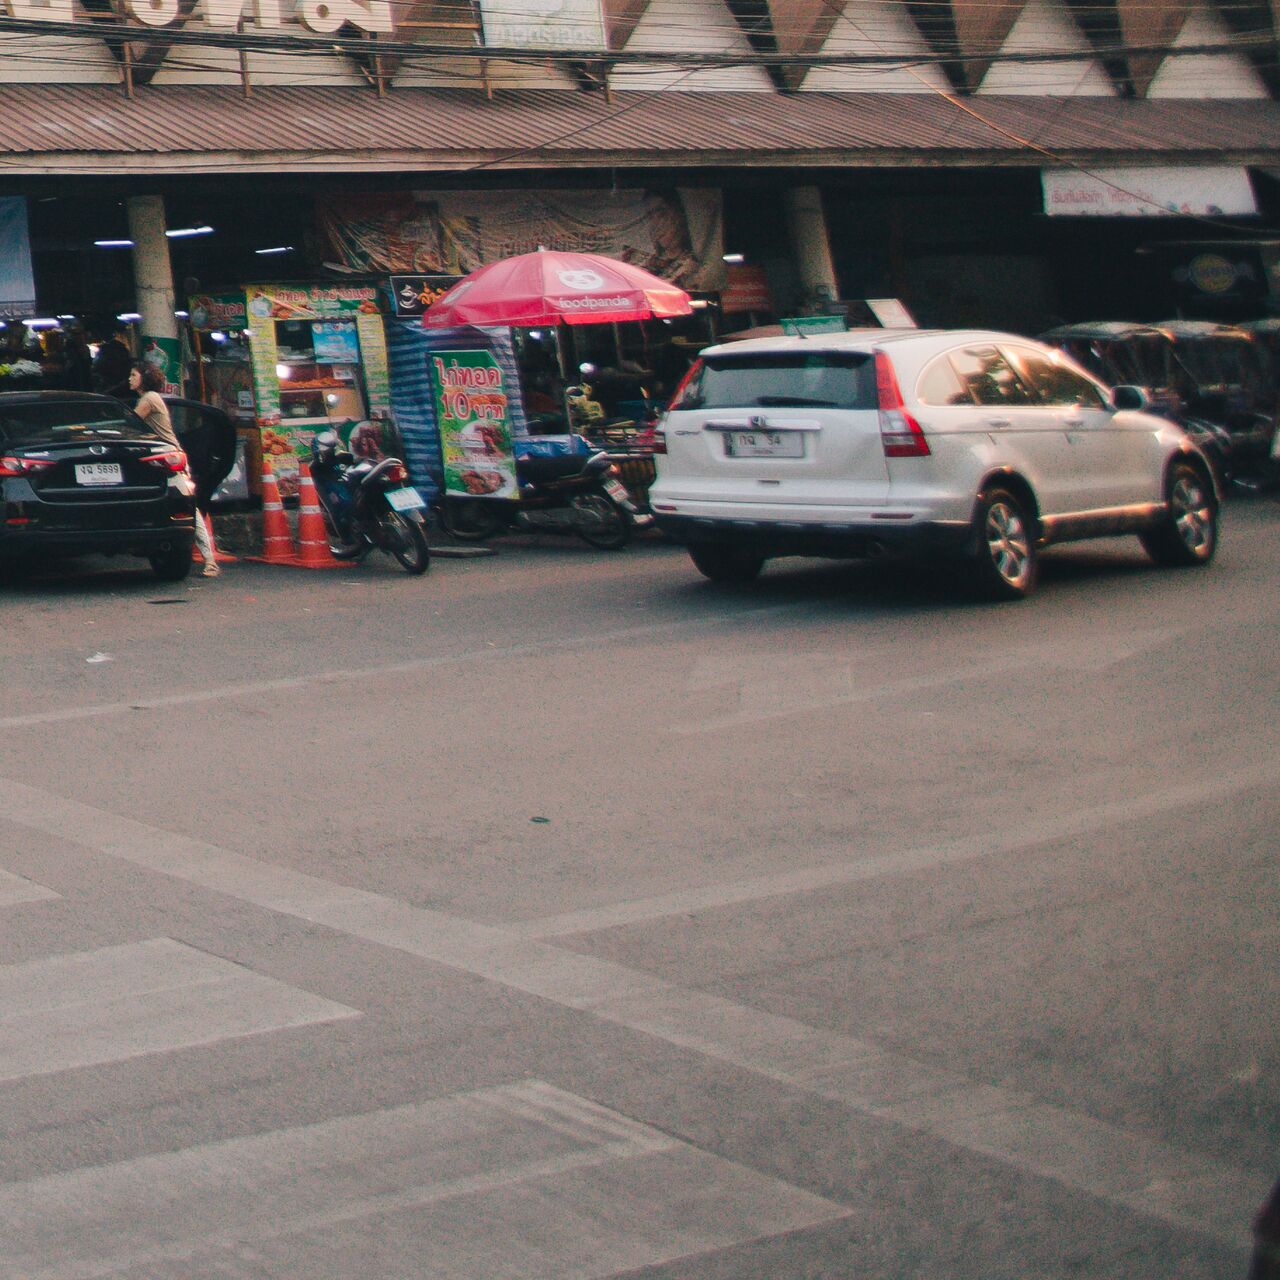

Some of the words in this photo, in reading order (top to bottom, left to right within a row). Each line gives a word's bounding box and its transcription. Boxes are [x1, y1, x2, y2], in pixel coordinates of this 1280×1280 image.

[559, 295, 631, 309] foodpanda
[434, 357, 502, 388] ไก่ทอด
[441, 392, 471, 420] 10
[474, 403, 506, 420] บาท
